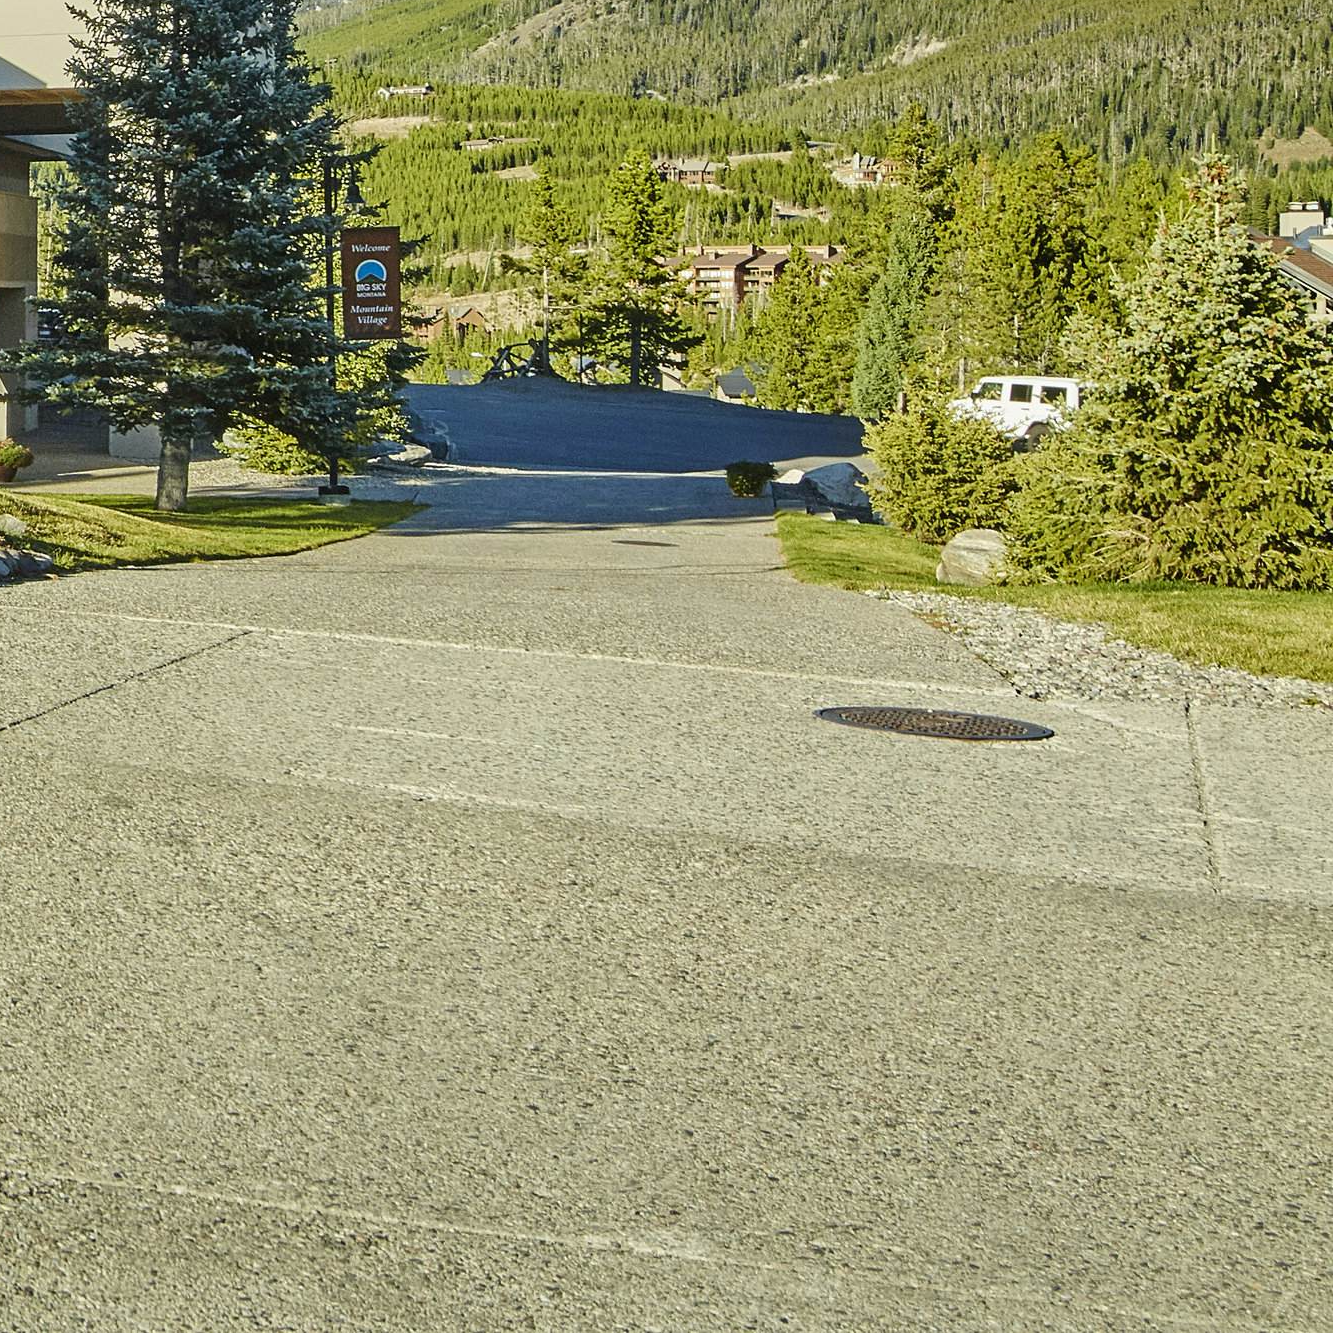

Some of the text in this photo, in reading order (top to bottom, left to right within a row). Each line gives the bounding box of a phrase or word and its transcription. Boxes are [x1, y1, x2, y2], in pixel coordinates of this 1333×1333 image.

[351, 244, 391, 253] Welcome
[356, 283, 387, 292] BIG SKY
[350, 305, 394, 314] Mountain
[357, 316, 389, 326] Village
